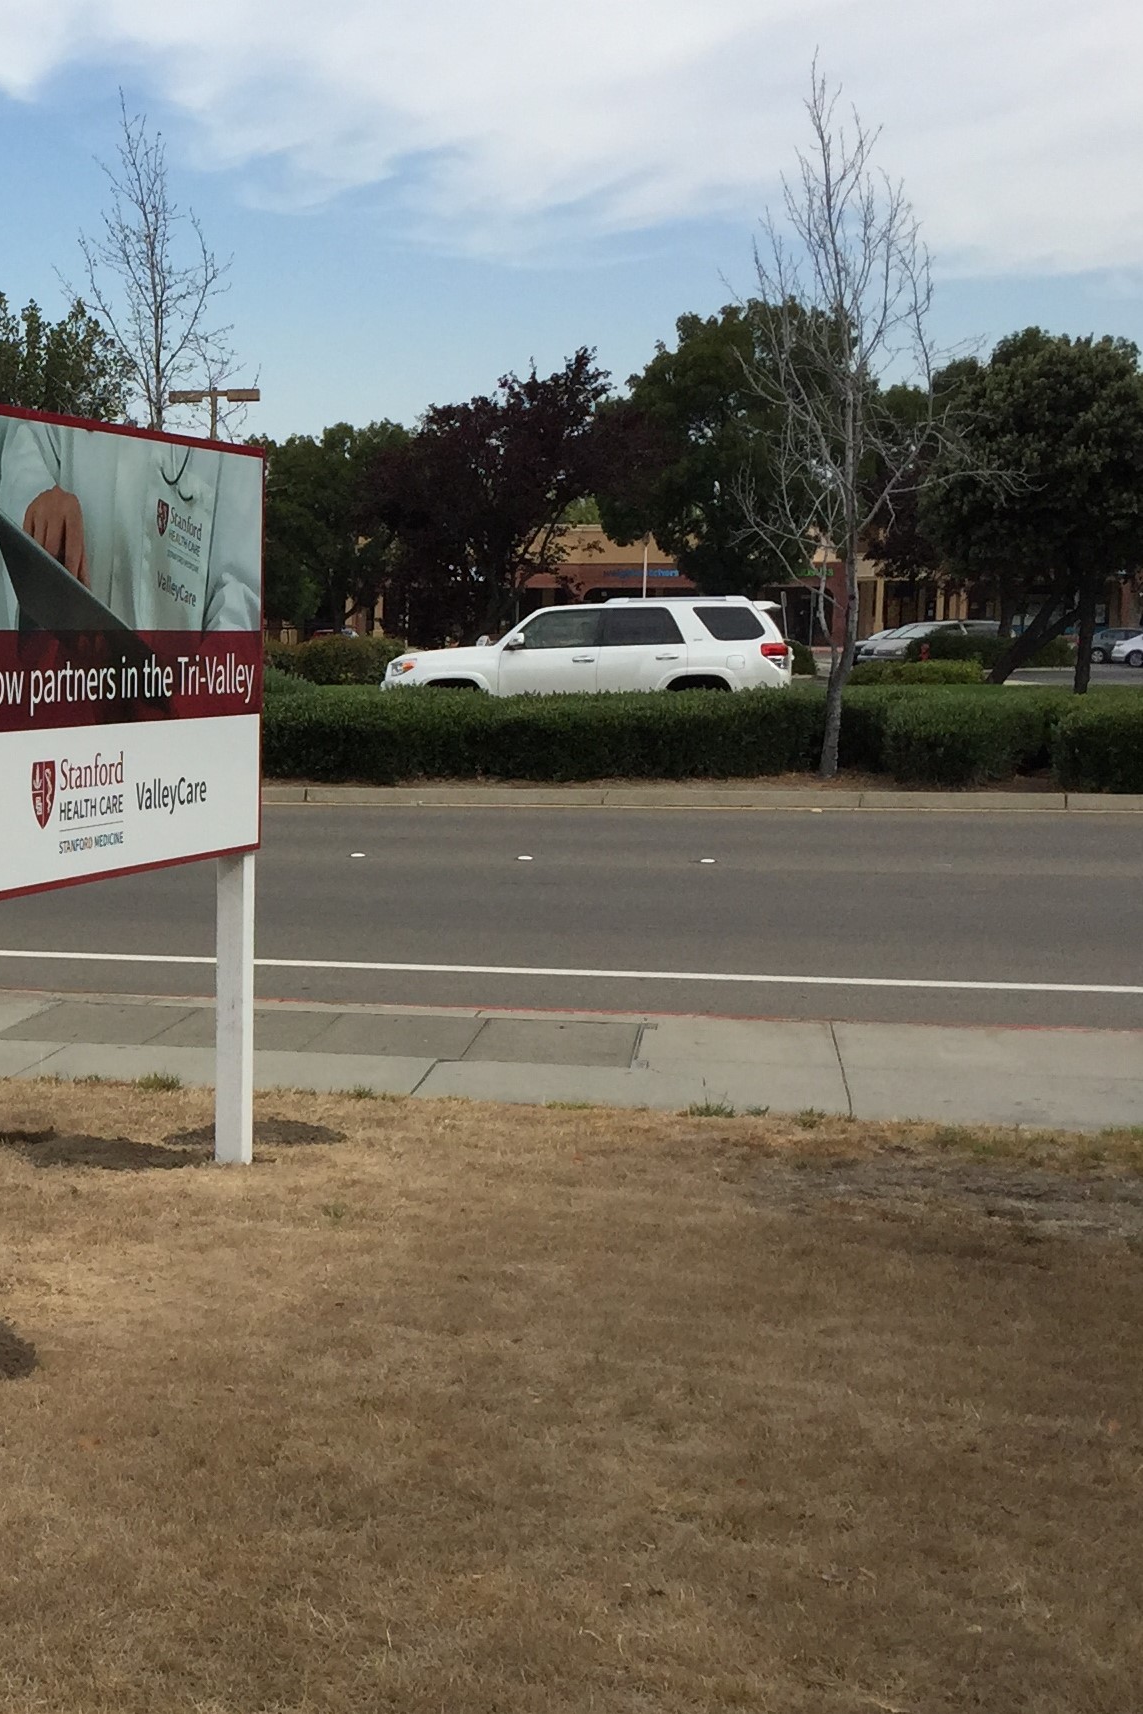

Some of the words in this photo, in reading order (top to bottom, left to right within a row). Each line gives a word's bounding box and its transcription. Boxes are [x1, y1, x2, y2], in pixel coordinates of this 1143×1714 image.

[170, 506, 202, 541] Stanford
[157, 570, 197, 607] ValleyCare
[30, 661, 116, 716] partners
[121, 656, 138, 699] in
[143, 654, 173, 698] the
[177, 653, 255, 704] Tri-Valley
[60, 751, 124, 790] Stanford
[59, 798, 96, 821] HEALTH
[99, 794, 124, 815] CARE
[136, 777, 207, 815] ValleyCare
[59, 836, 93, 854] STANFORD
[94, 831, 124, 848] MEDICINE
